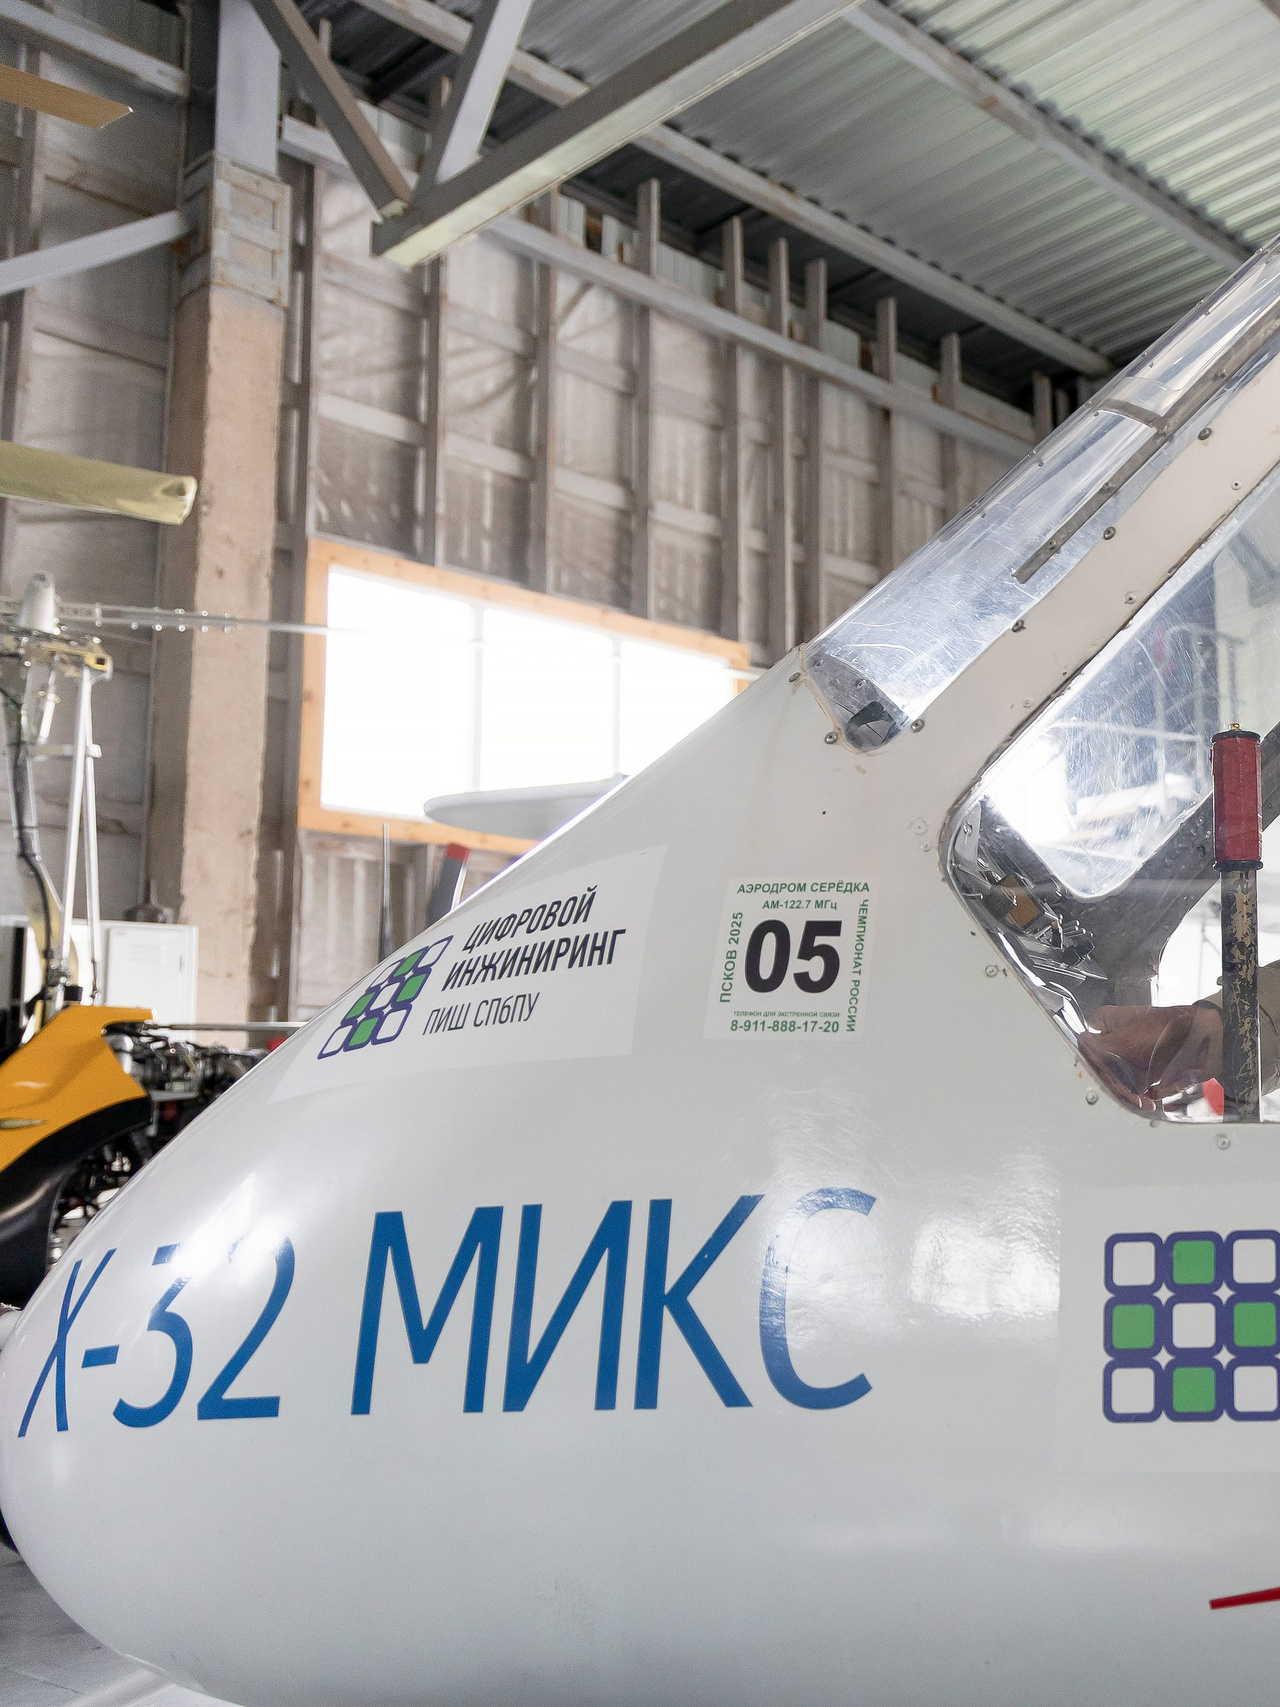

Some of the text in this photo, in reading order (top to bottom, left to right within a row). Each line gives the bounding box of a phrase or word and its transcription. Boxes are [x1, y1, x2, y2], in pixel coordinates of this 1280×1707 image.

[461, 885, 599, 954] ЦИФРОВОЙ
[737, 880, 870, 894] АЭРОДРОМ СЕРЁДКА
[762, 900, 837, 910] АМ-122.7 МГц
[441, 929, 627, 991] ИНЖИНИРИНГ
[719, 912, 743, 1003] ПСКОВ 2025
[744, 919, 842, 993] 05
[846, 899, 869, 1032] ЧЕМПИОНАТ РОССИИ
[422, 1002, 473, 1035] ПИШ
[730, 1019, 840, 1033] 8-911-888-17-20
[17, 1187, 877, 1439] Х-32 МИКС
